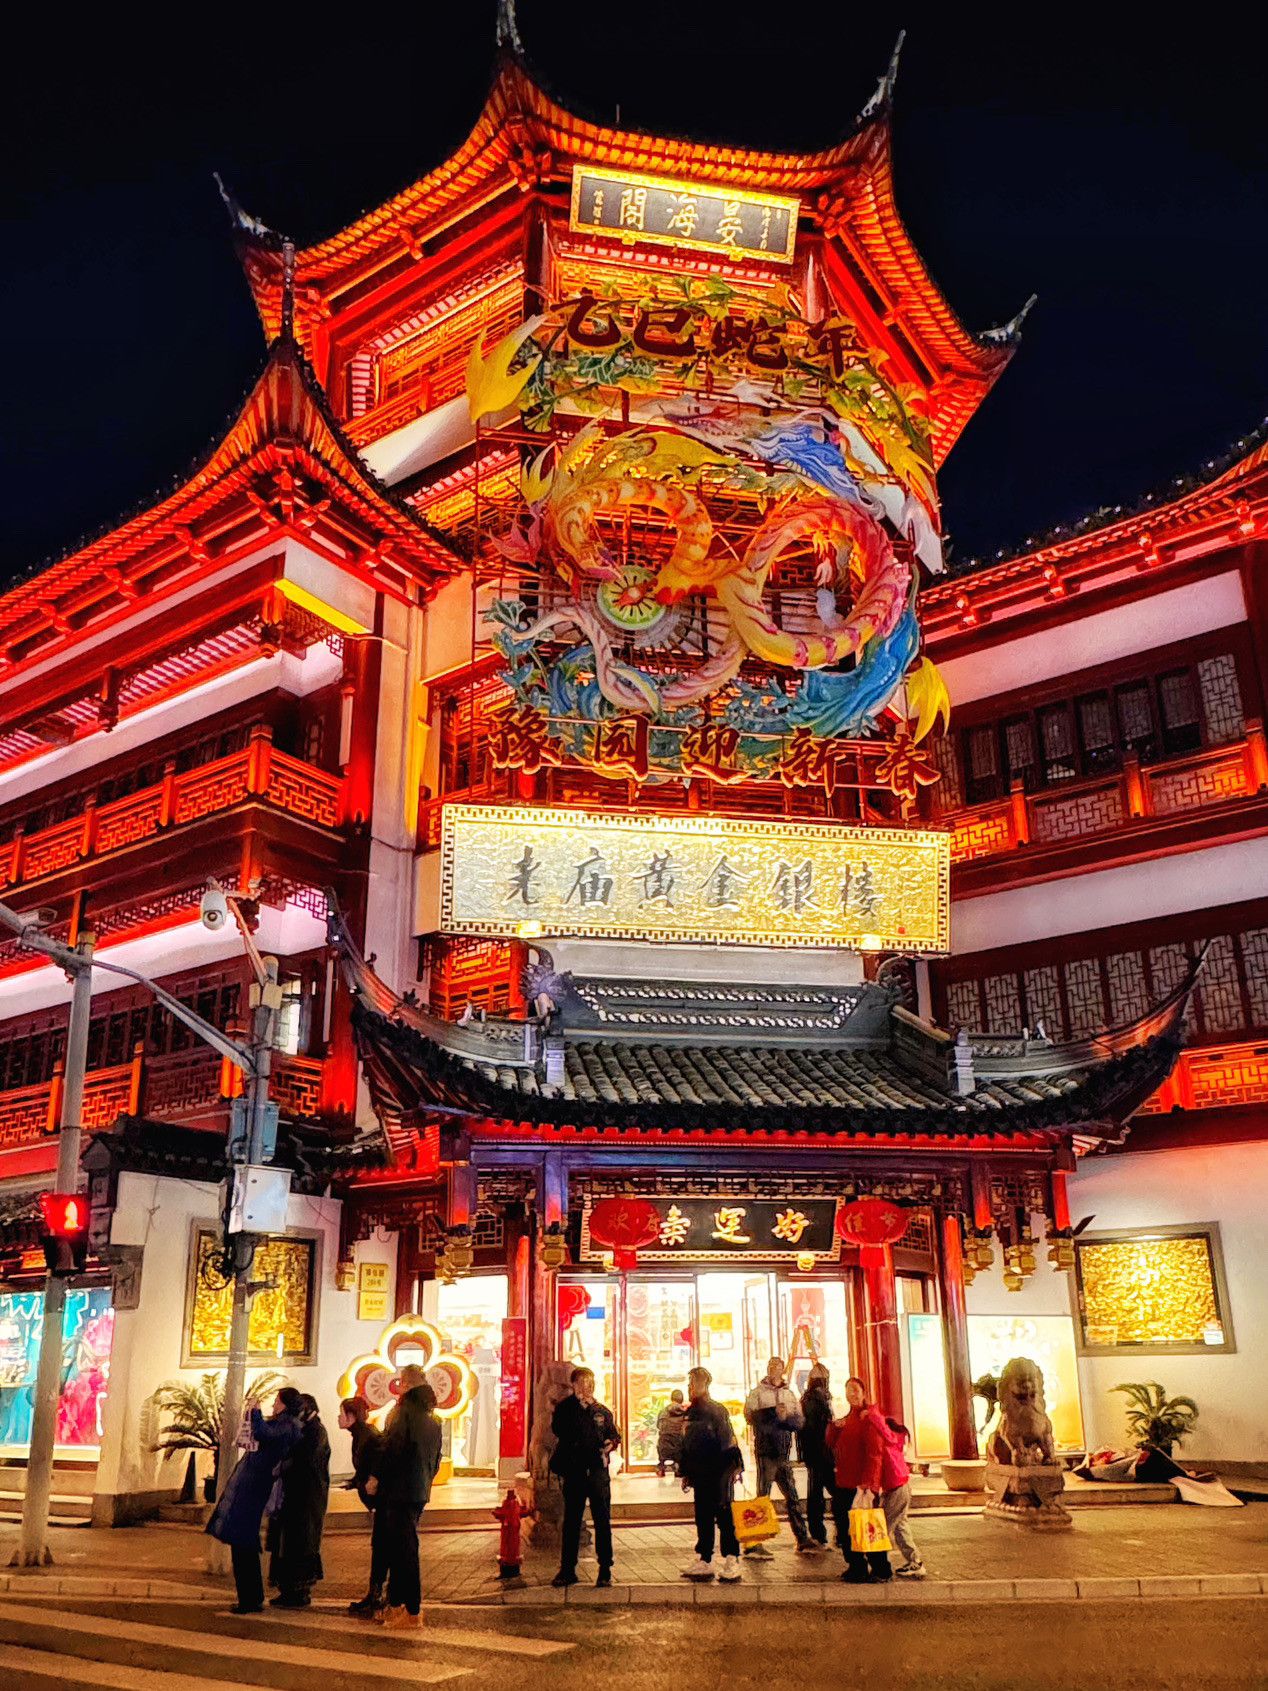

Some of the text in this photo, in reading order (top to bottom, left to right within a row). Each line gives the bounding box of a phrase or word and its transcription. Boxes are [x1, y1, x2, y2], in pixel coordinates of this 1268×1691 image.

[489, 704, 941, 799] 豫园迎新春
